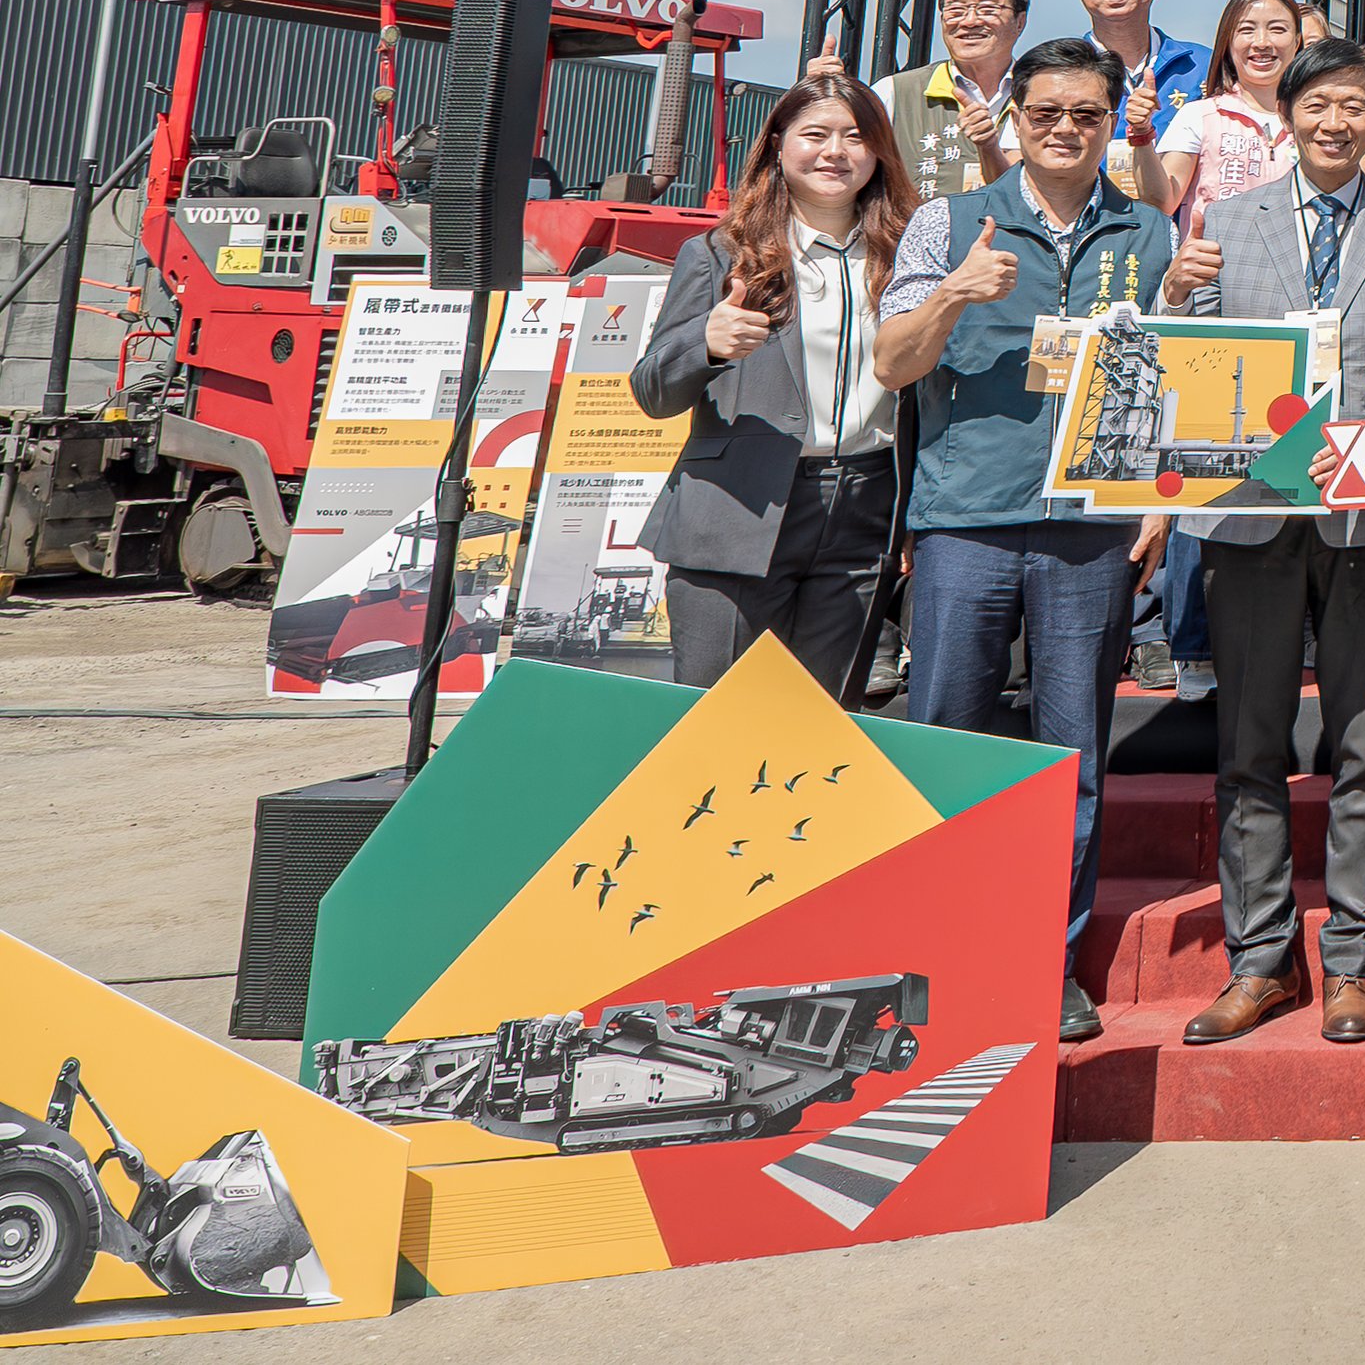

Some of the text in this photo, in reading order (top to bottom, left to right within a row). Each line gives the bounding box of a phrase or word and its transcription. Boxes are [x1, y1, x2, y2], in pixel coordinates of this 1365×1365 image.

[943, 123, 961, 162] 特助
[918, 133, 941, 199] 黃福得
[184, 207, 260, 224] VOLVO
